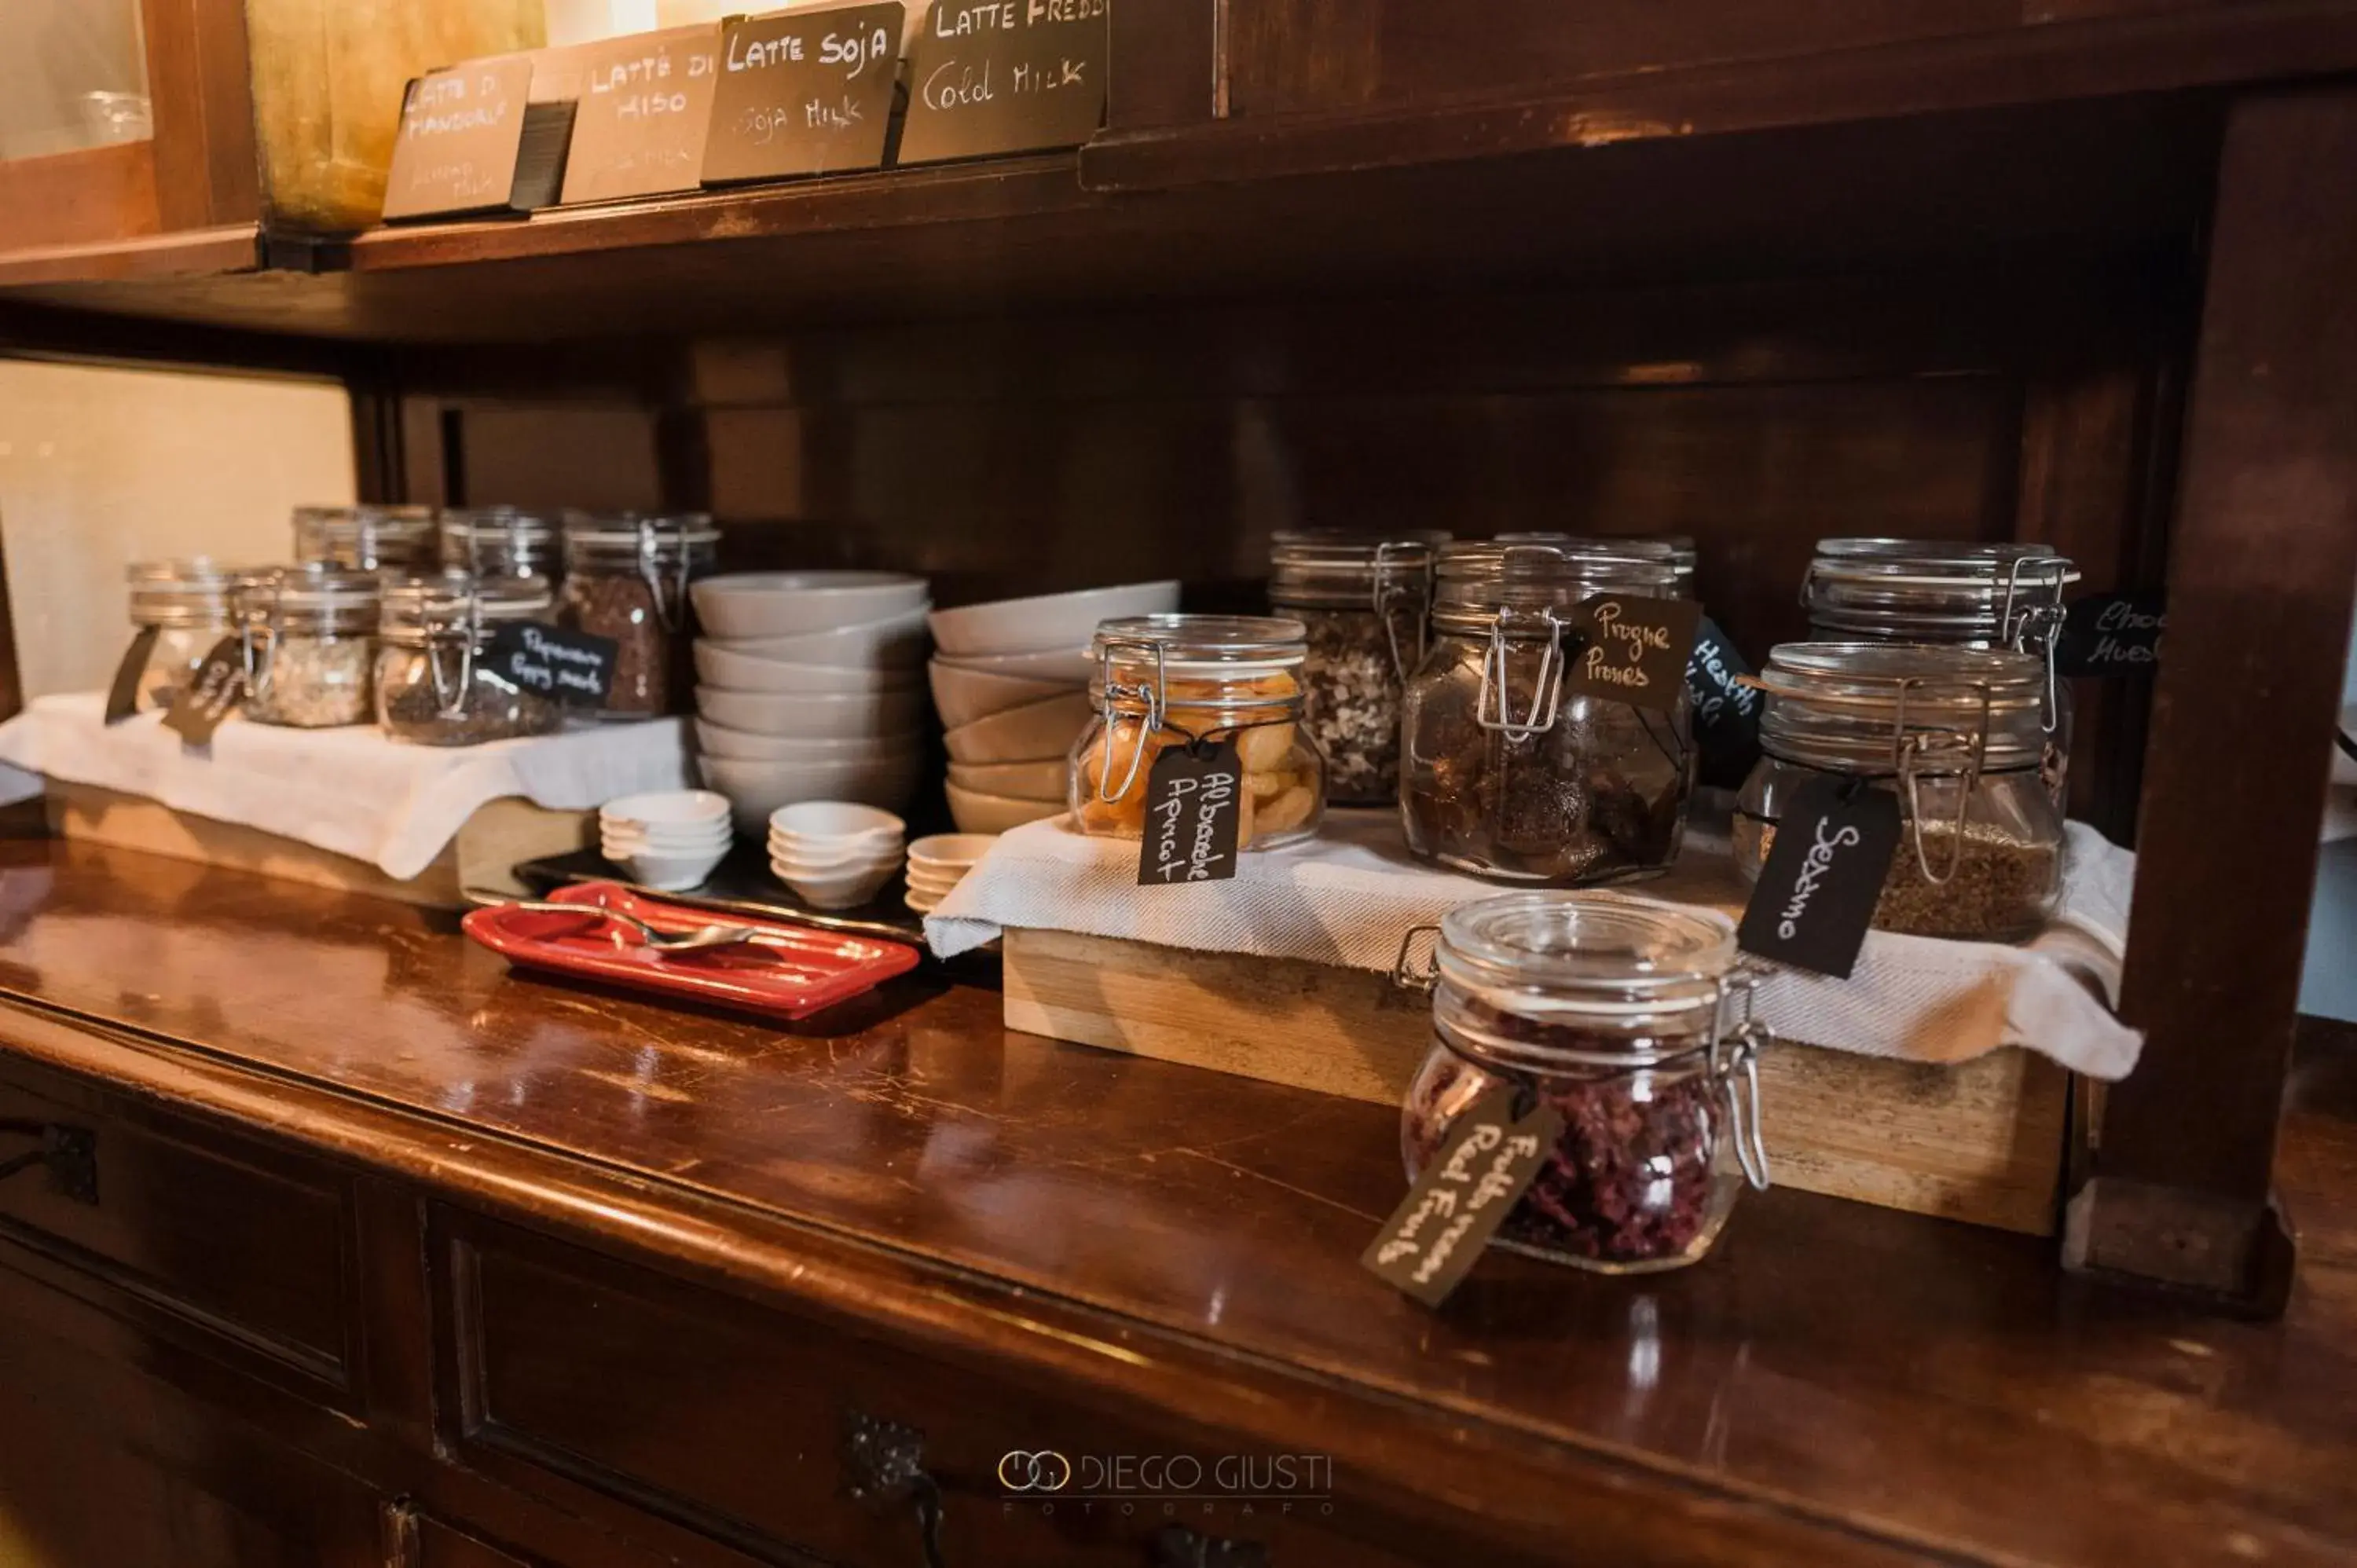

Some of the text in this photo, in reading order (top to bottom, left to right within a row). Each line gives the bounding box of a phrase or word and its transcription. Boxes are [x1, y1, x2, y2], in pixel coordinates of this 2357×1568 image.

[936, 3, 1016, 38] LATTE
[726, 29, 805, 72] LATTE
[923, 58, 994, 110] Cold
[1153, 778, 1198, 881] Apricot
